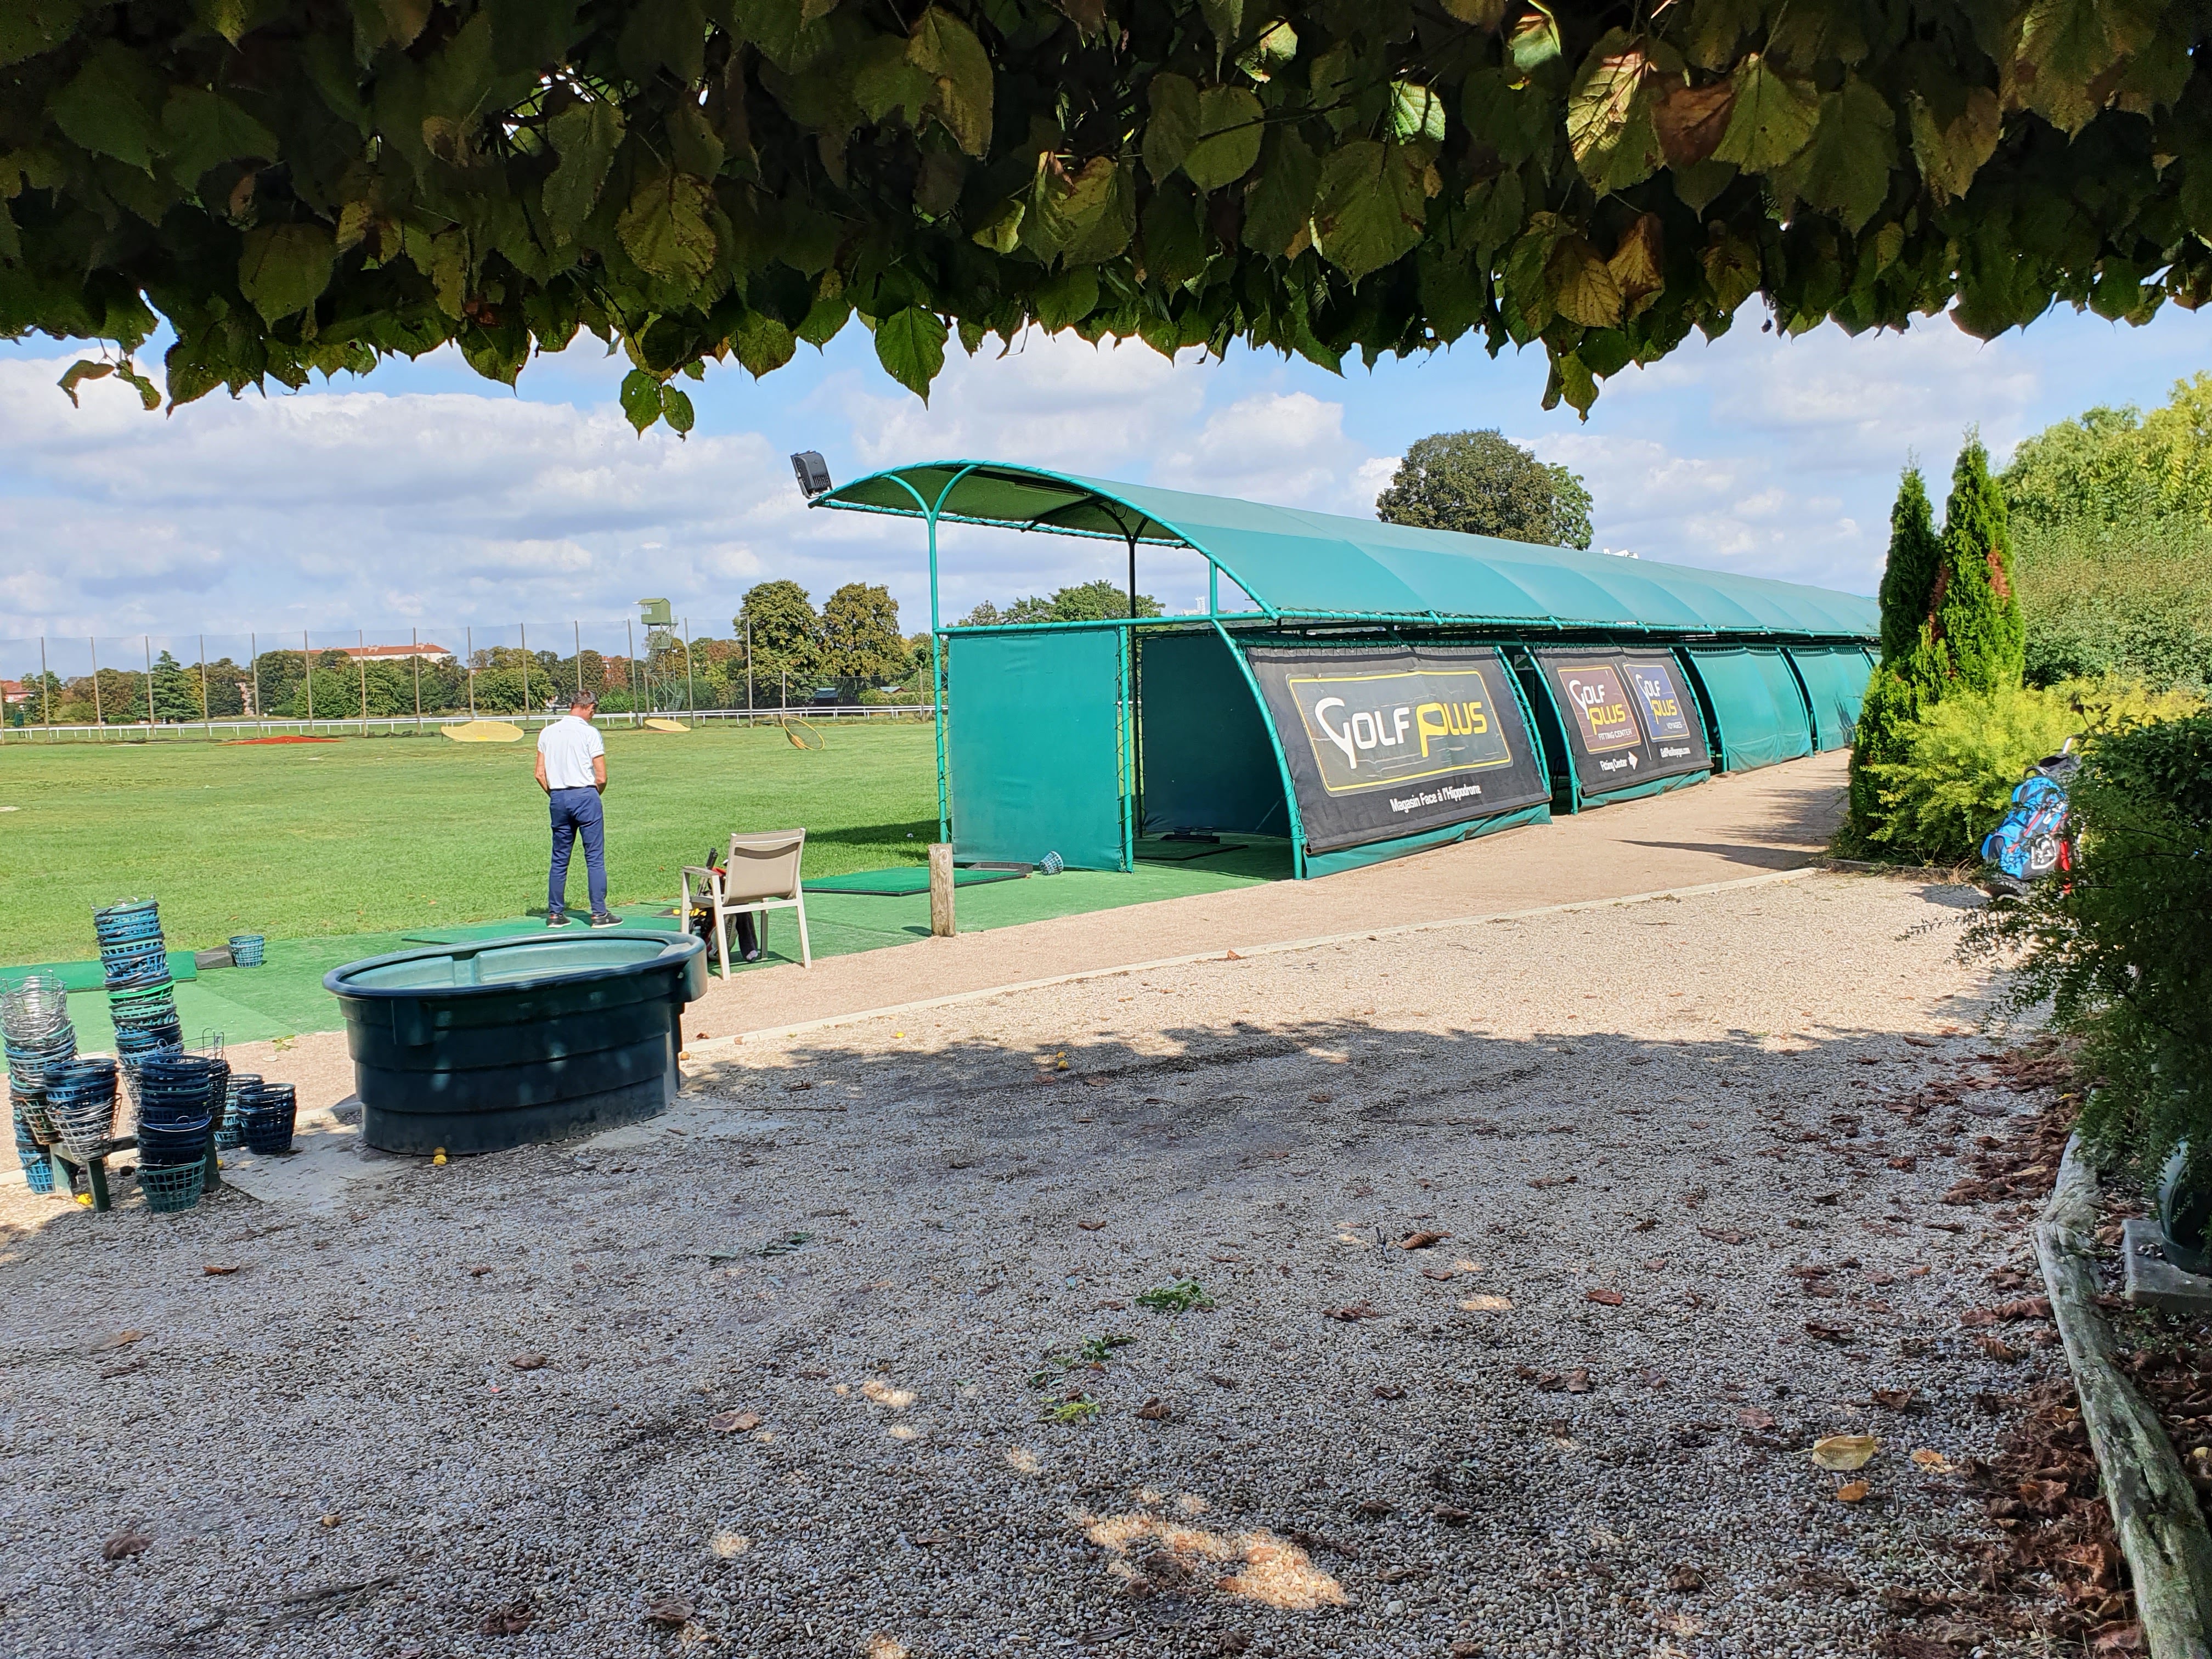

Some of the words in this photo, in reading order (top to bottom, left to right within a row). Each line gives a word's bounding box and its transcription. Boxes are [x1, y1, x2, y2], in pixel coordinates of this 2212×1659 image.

[1569, 679, 1605, 720] GOLF
[1635, 674, 1661, 710] GOLF
[1589, 703, 1626, 736] PLUS
[1651, 699, 1678, 725] PLUS
[1666, 721, 1683, 730] VOYAGES
[1314, 697, 1410, 769] GOLF
[1415, 702, 1488, 758] PLUS
[1598, 731, 1615, 741] FITTING
[1614, 728, 1633, 738] CENTER
[1389, 794, 1421, 814] Magasin
[1419, 792, 1438, 806] Face
[1437, 789, 1444, 802] à
[1442, 783, 1482, 802] l'Hippodrome
